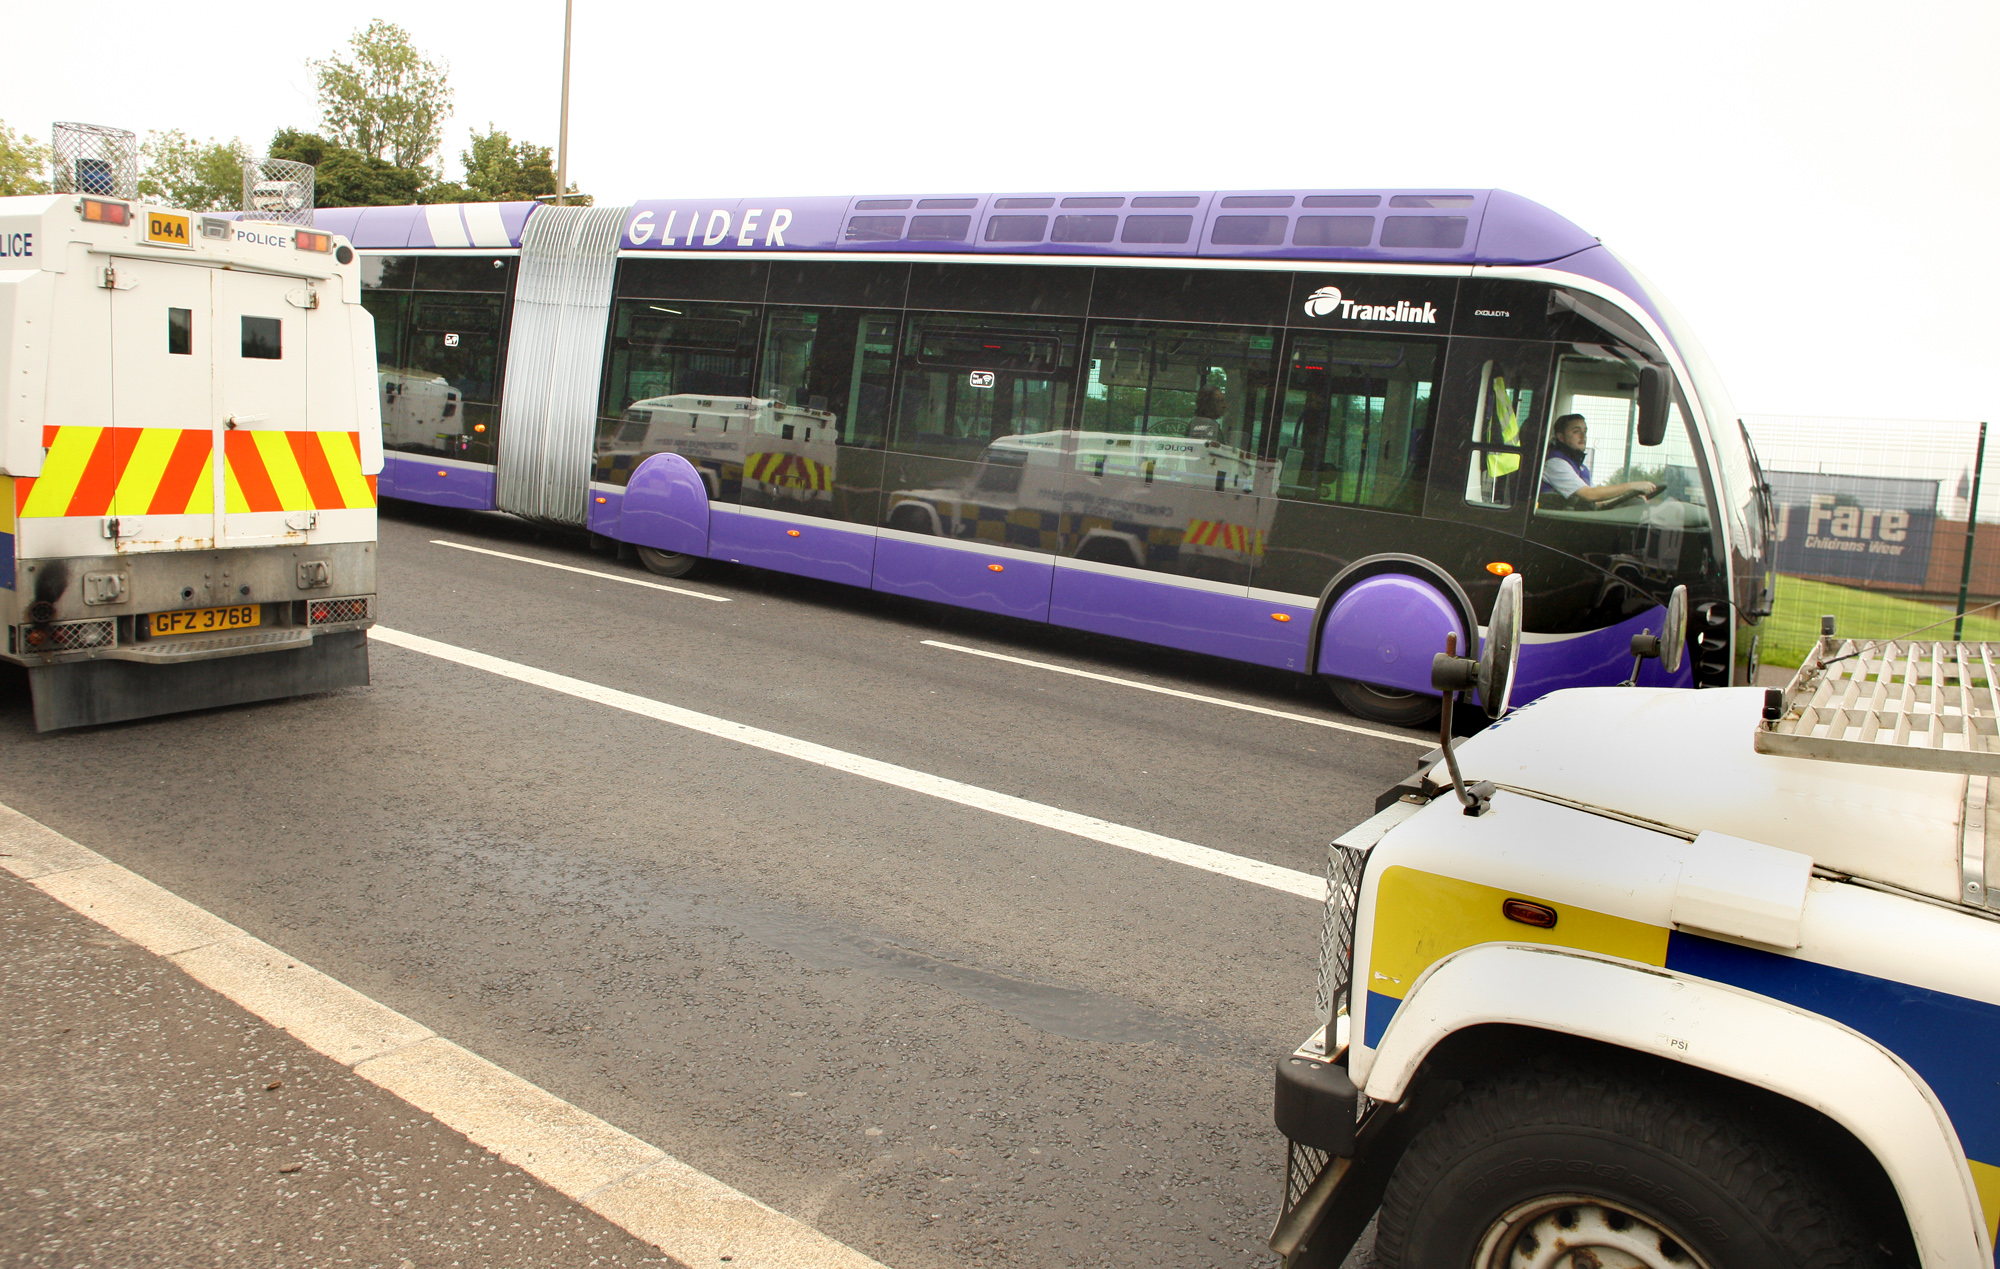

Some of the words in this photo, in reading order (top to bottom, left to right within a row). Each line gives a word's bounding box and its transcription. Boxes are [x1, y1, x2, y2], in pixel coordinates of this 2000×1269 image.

[237, 230, 286, 248] POLICE
[628, 208, 793, 247] GLIDER
[1340, 300, 1437, 324] Translink
[1807, 494, 1910, 542] Fare
[1805, 535, 1866, 553] Childrens
[1869, 540, 1906, 556] Wear
[156, 611, 197, 632] GFZ
[203, 606, 252, 628] 3768
[1671, 1039, 1688, 1051] PSI
